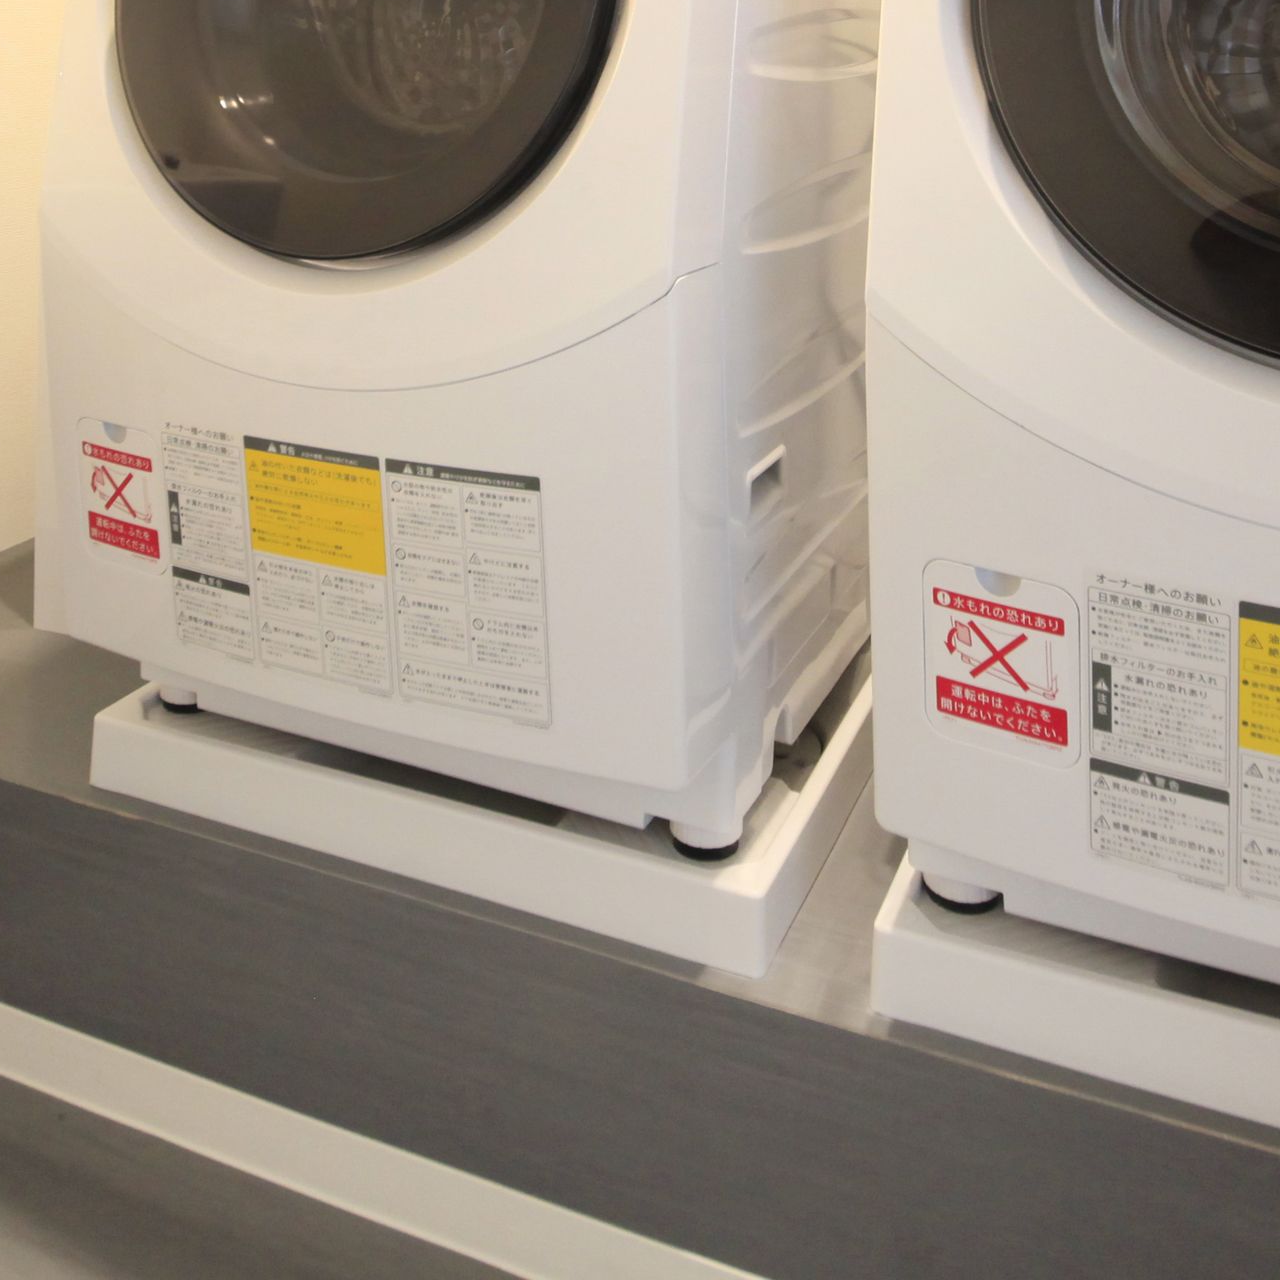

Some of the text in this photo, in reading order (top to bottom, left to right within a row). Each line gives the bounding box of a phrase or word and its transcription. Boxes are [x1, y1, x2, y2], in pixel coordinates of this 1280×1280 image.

[1096, 574, 1222, 606] オーナー様へのお願い
[953, 597, 1059, 631] 水もれの恐れあり
[1100, 653, 1218, 686] 排水フィルターのお手入れ
[951, 684, 1051, 722] 運転中は、ふたを
[1125, 674, 1208, 699] 水漏れの恐れあり
[940, 698, 1063, 742] 開けないでください。
